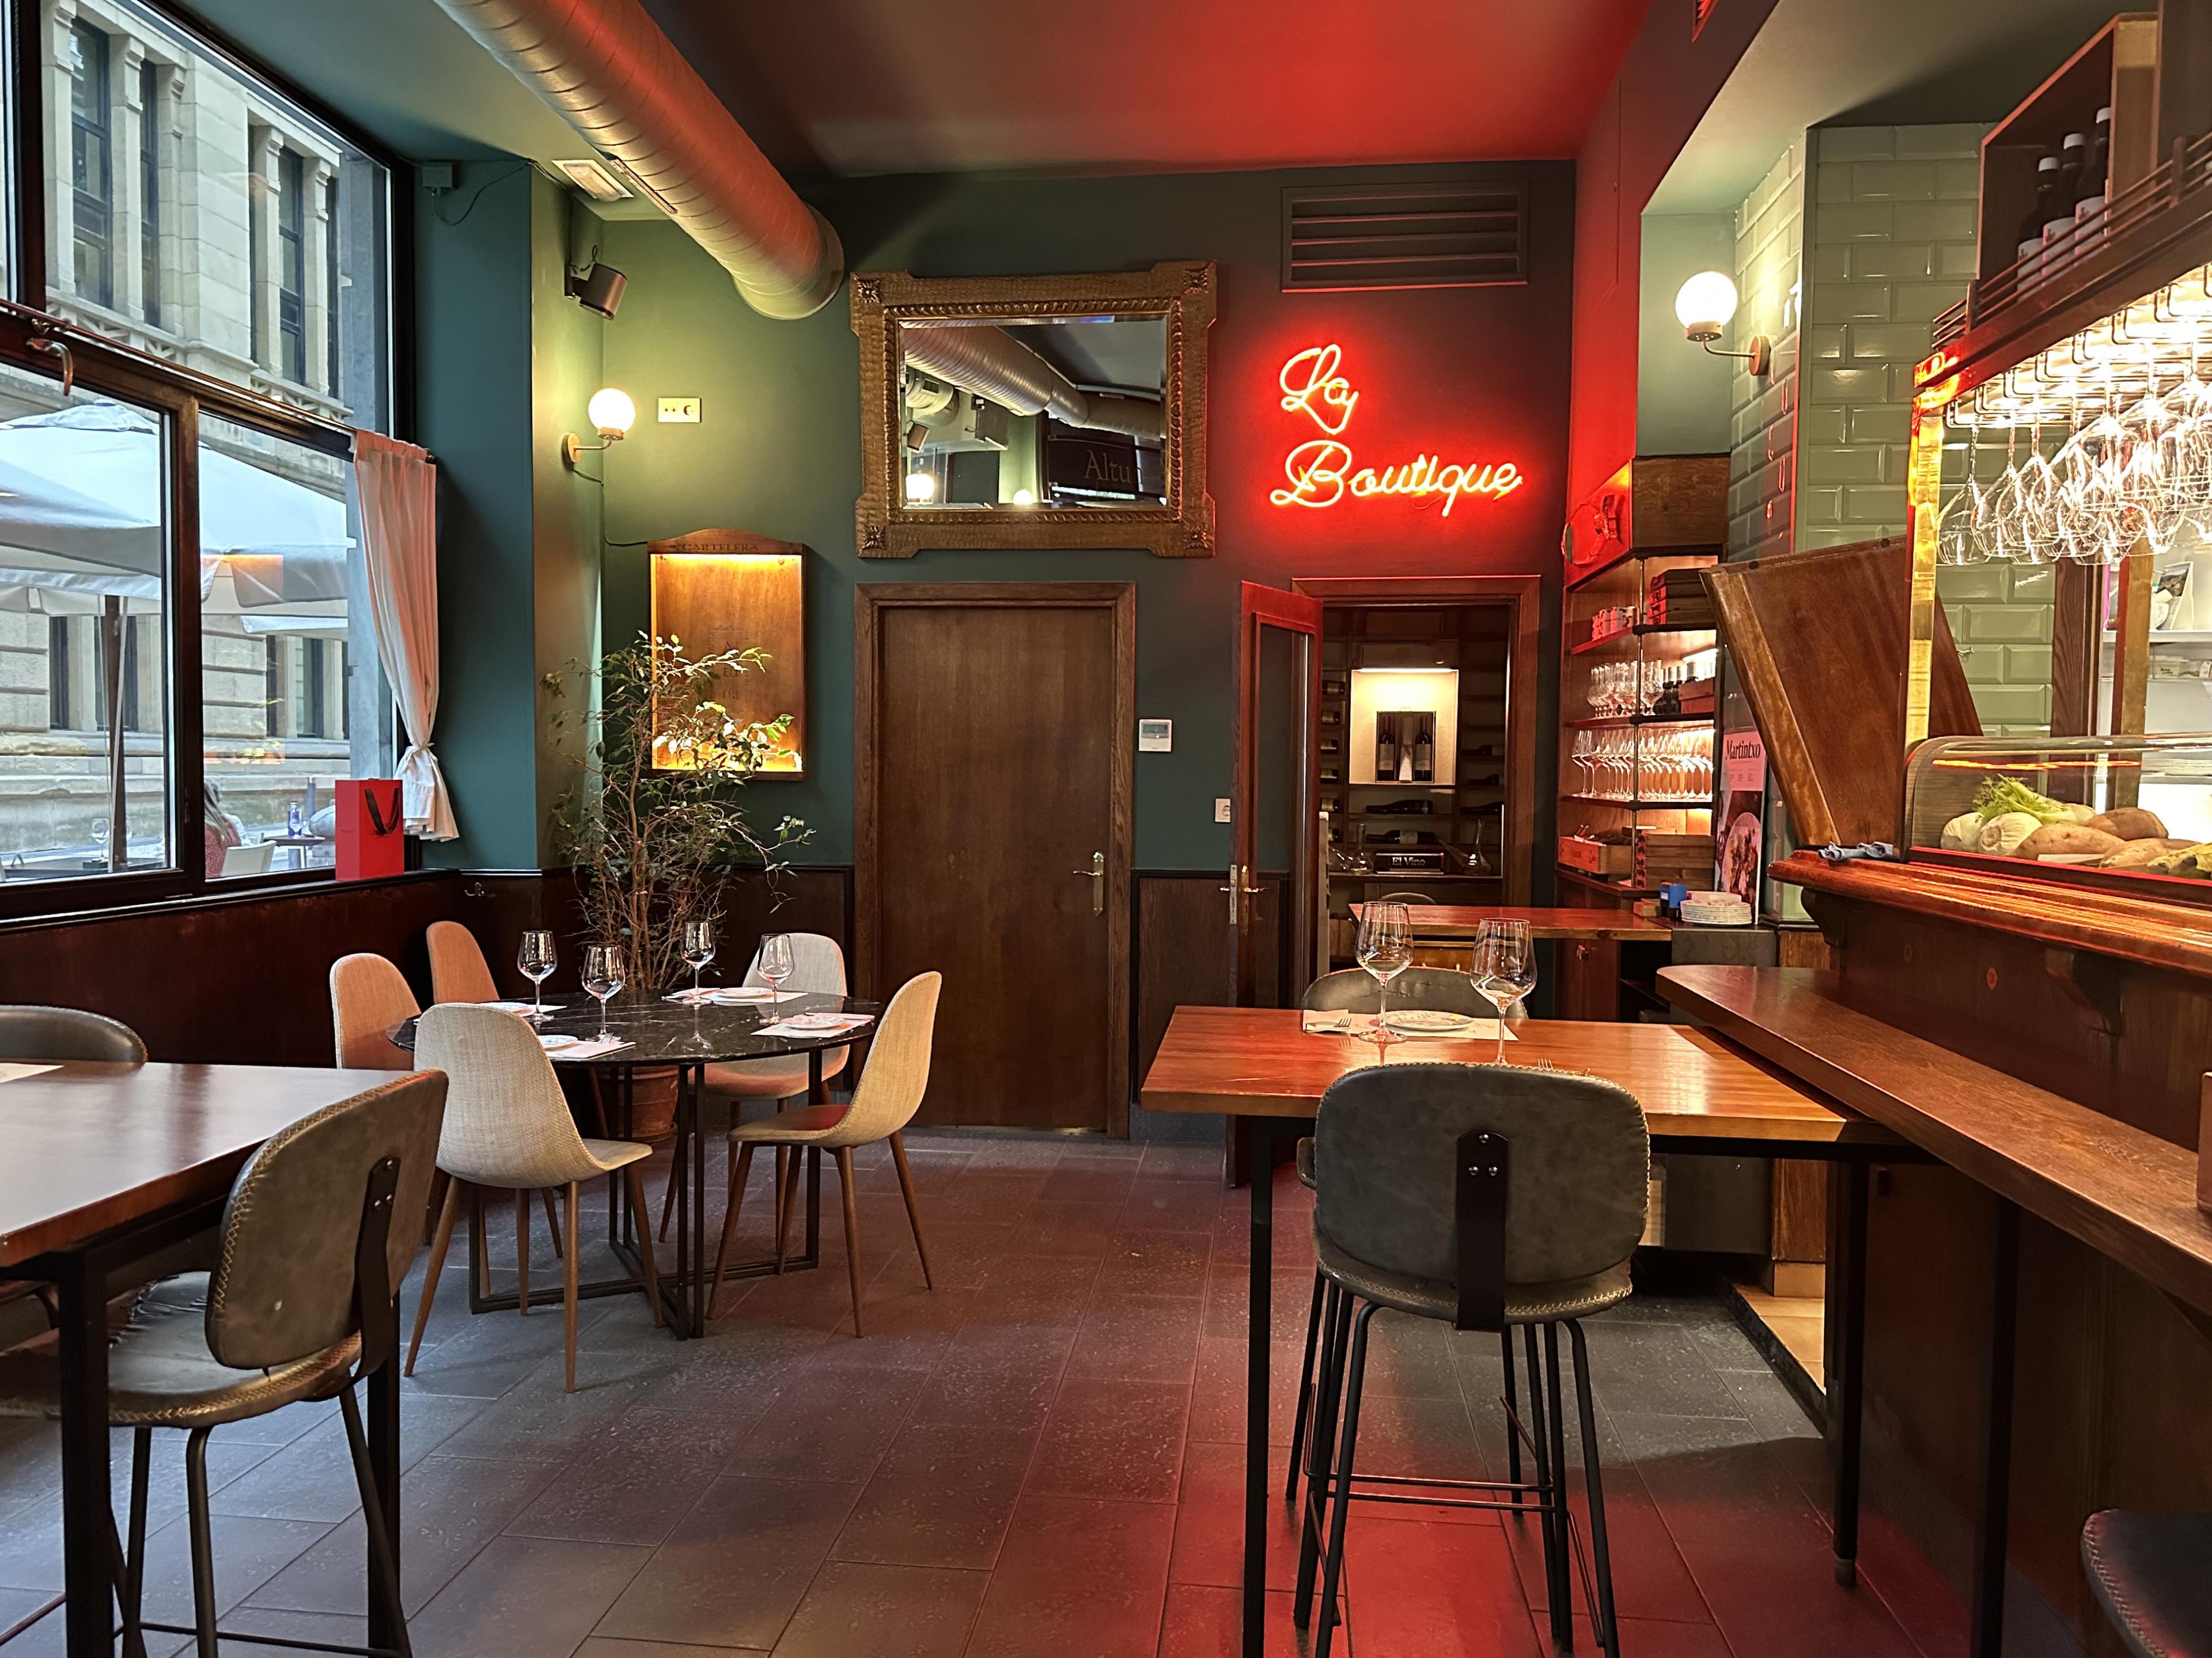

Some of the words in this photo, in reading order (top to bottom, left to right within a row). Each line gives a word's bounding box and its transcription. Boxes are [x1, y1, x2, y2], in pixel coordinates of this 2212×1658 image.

[1279, 344, 1359, 435] La
[1270, 439, 1523, 517] Boutique
[681, 543, 759, 551] CARTELERA
[1725, 740, 1761, 760] Martintxo
[1392, 857, 1402, 866] El
[1404, 857, 1426, 866] Vino
